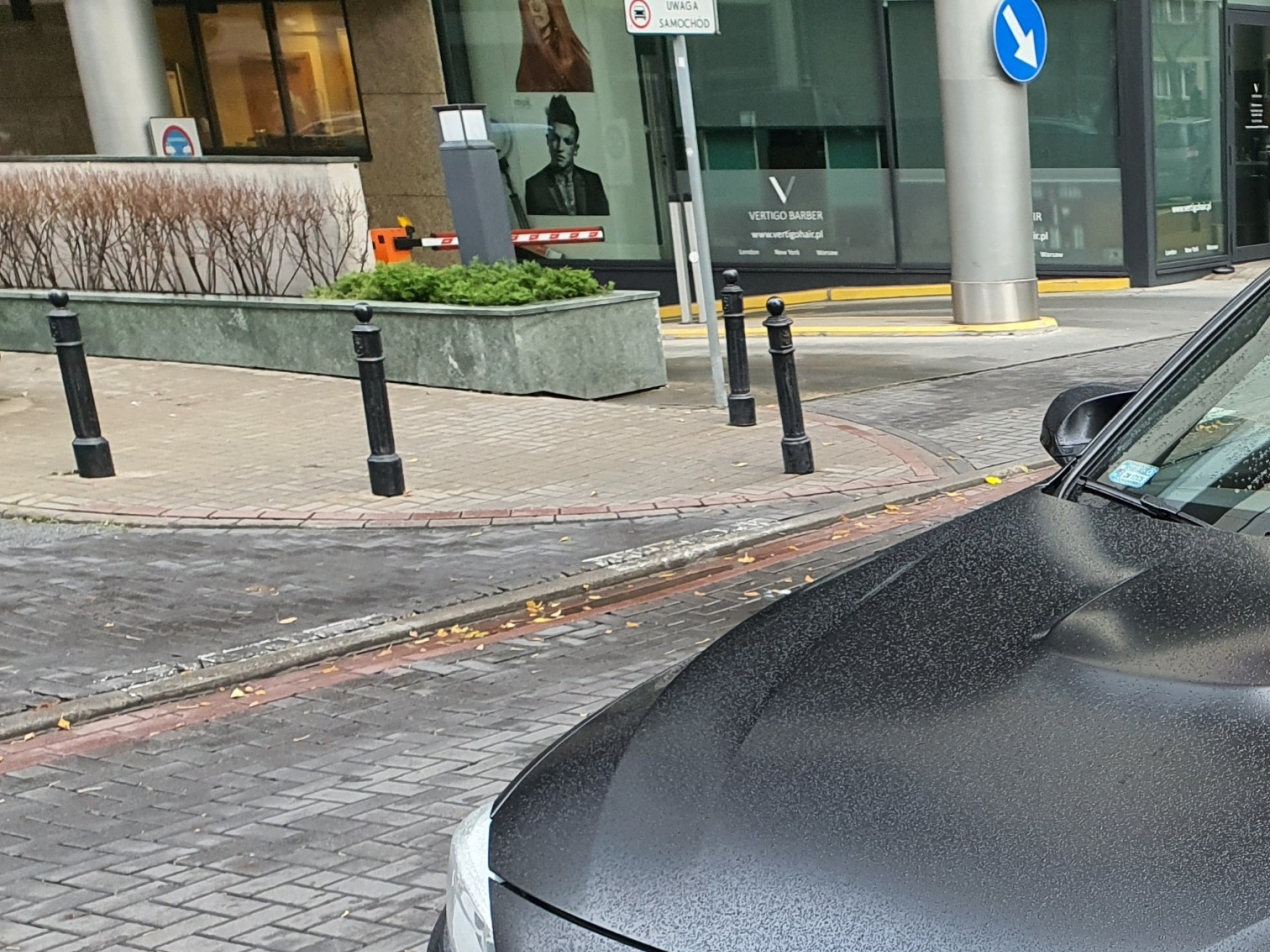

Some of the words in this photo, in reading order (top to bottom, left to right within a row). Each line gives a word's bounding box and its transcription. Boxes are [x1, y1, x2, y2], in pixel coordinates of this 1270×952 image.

[666, 1, 699, 11] UWAGA
[768, 176, 796, 204] V
[748, 210, 787, 221] VERTIGO
[789, 210, 824, 221] BARBER
[751, 229, 824, 240] www.vertigohair.pl
